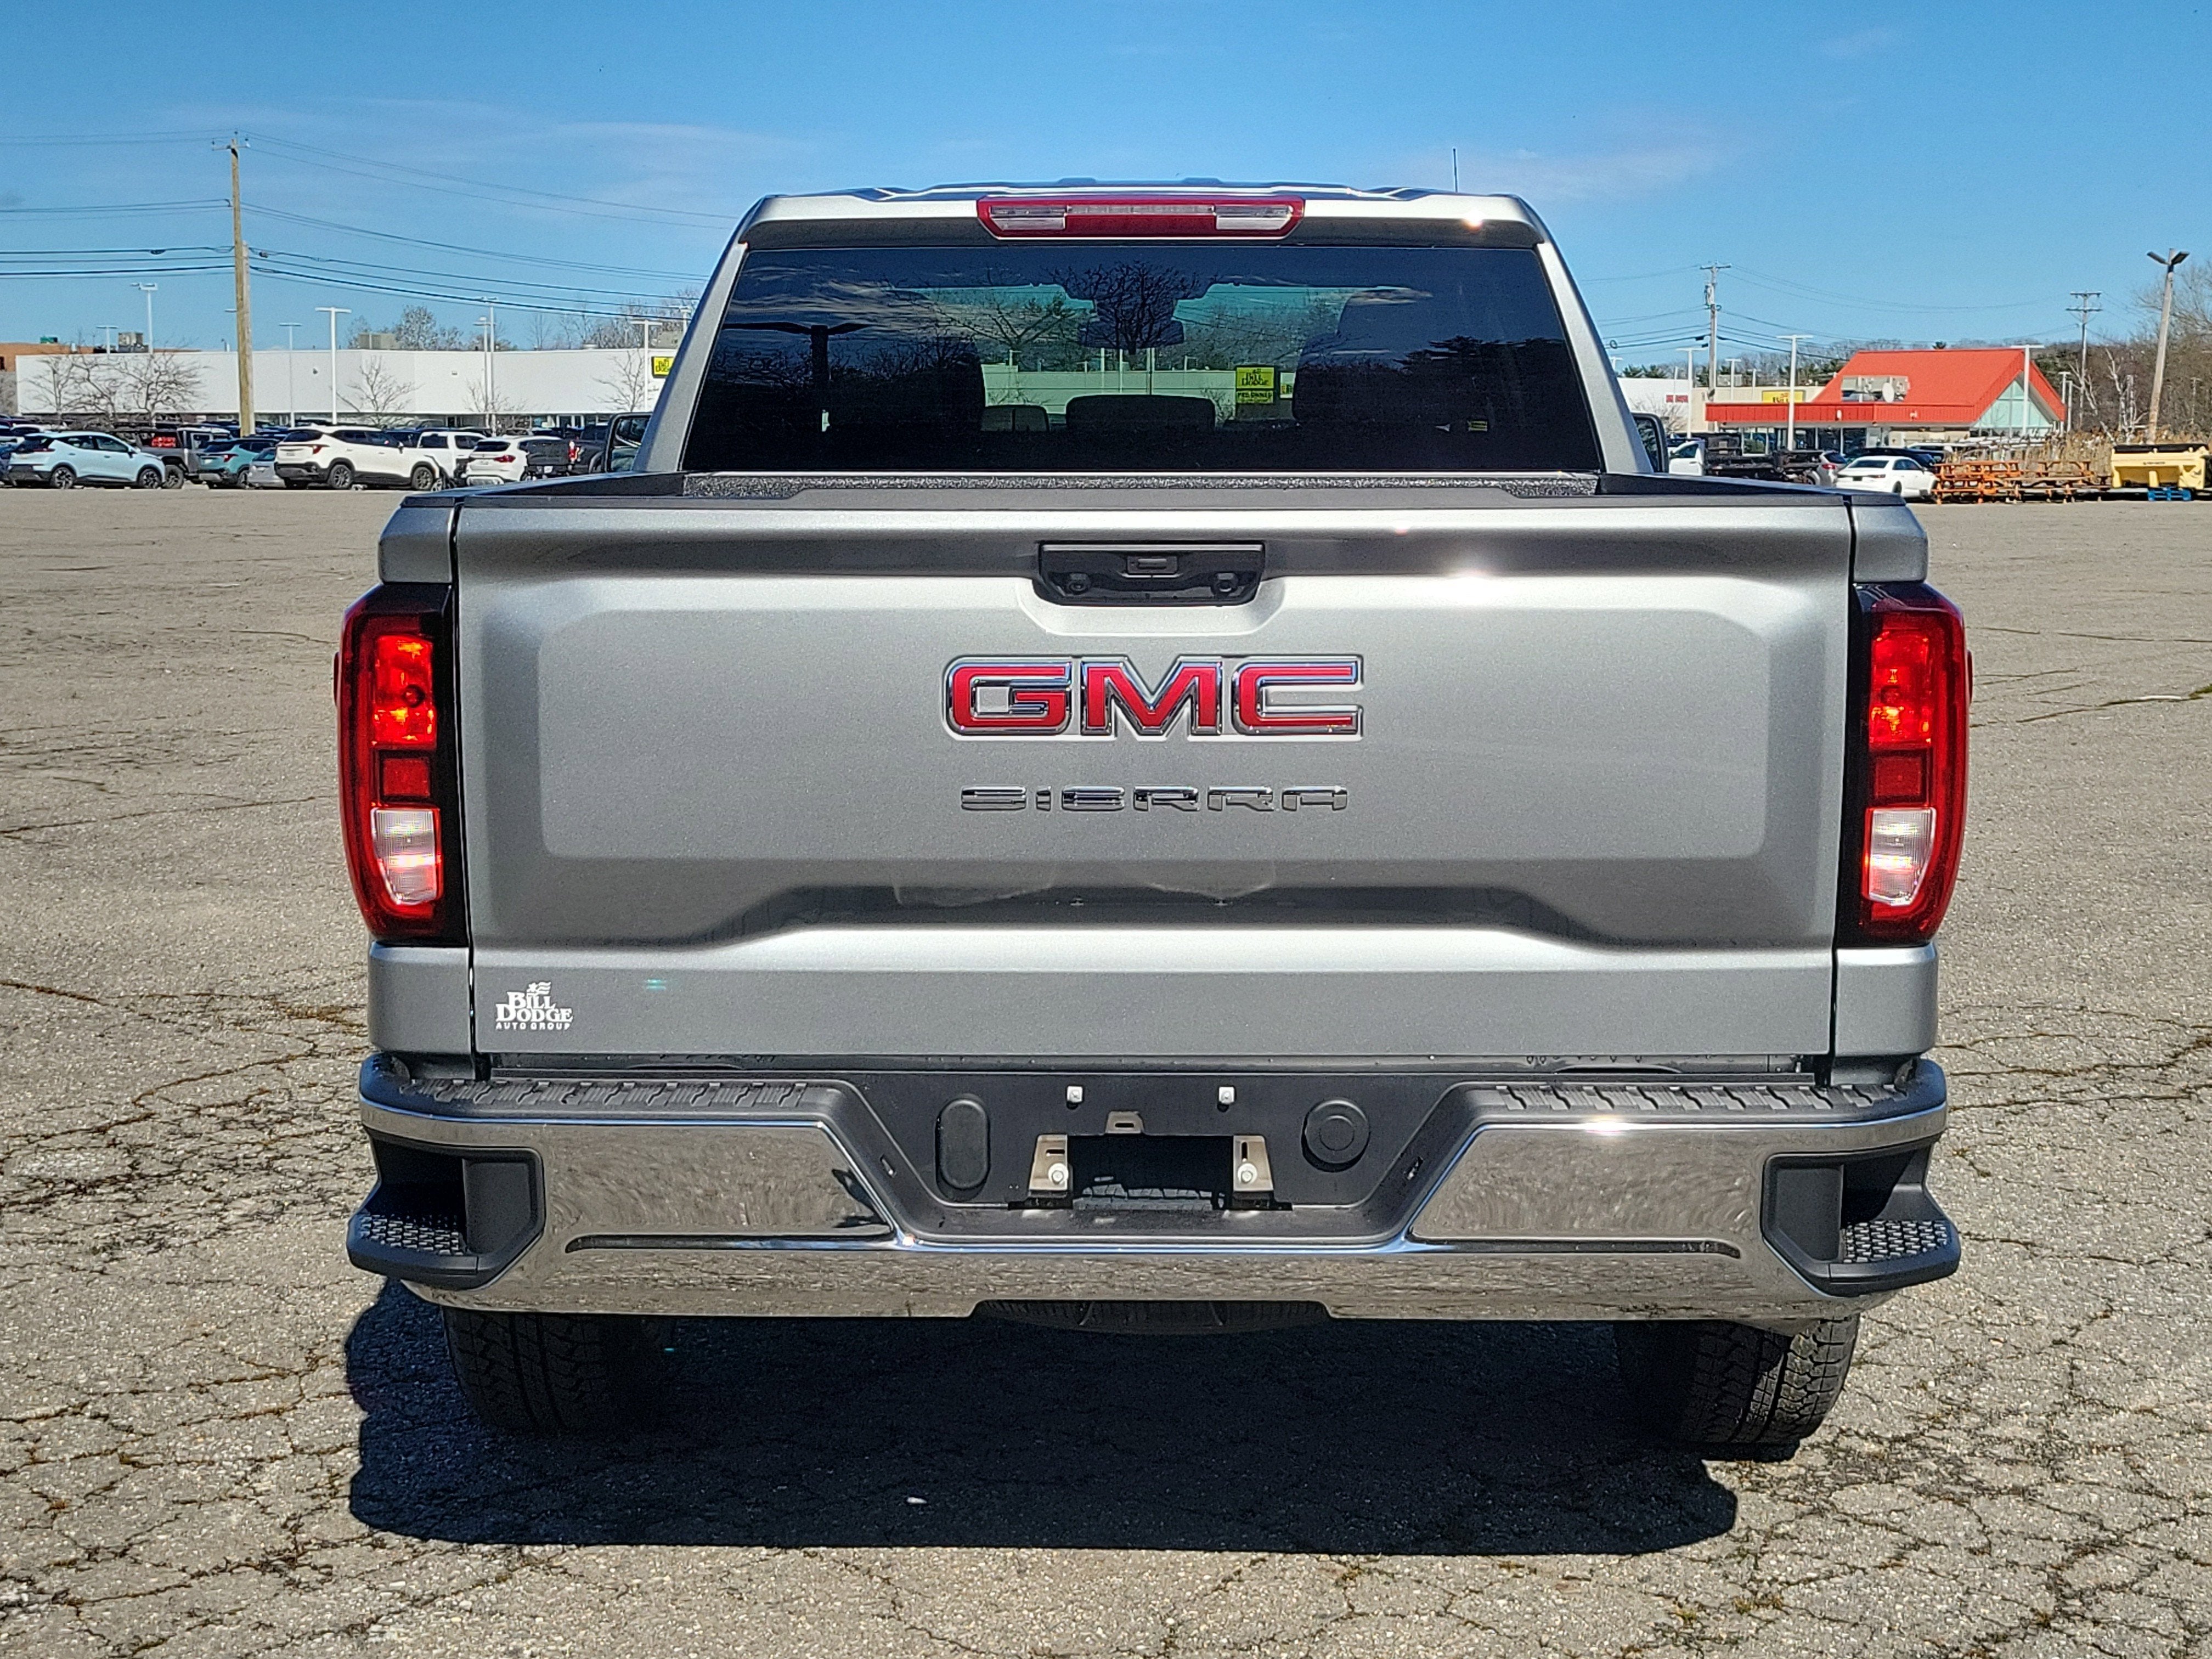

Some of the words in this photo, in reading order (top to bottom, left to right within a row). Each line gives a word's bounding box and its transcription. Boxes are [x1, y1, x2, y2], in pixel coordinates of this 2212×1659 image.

[945, 657, 1362, 738] GMC
[961, 786, 1347, 811] SIERRA
[506, 991, 556, 1009] BILL
[495, 1003, 573, 1022] DODGE
[495, 1022, 527, 1030] AUTO
[530, 1022, 571, 1030] GROUP
